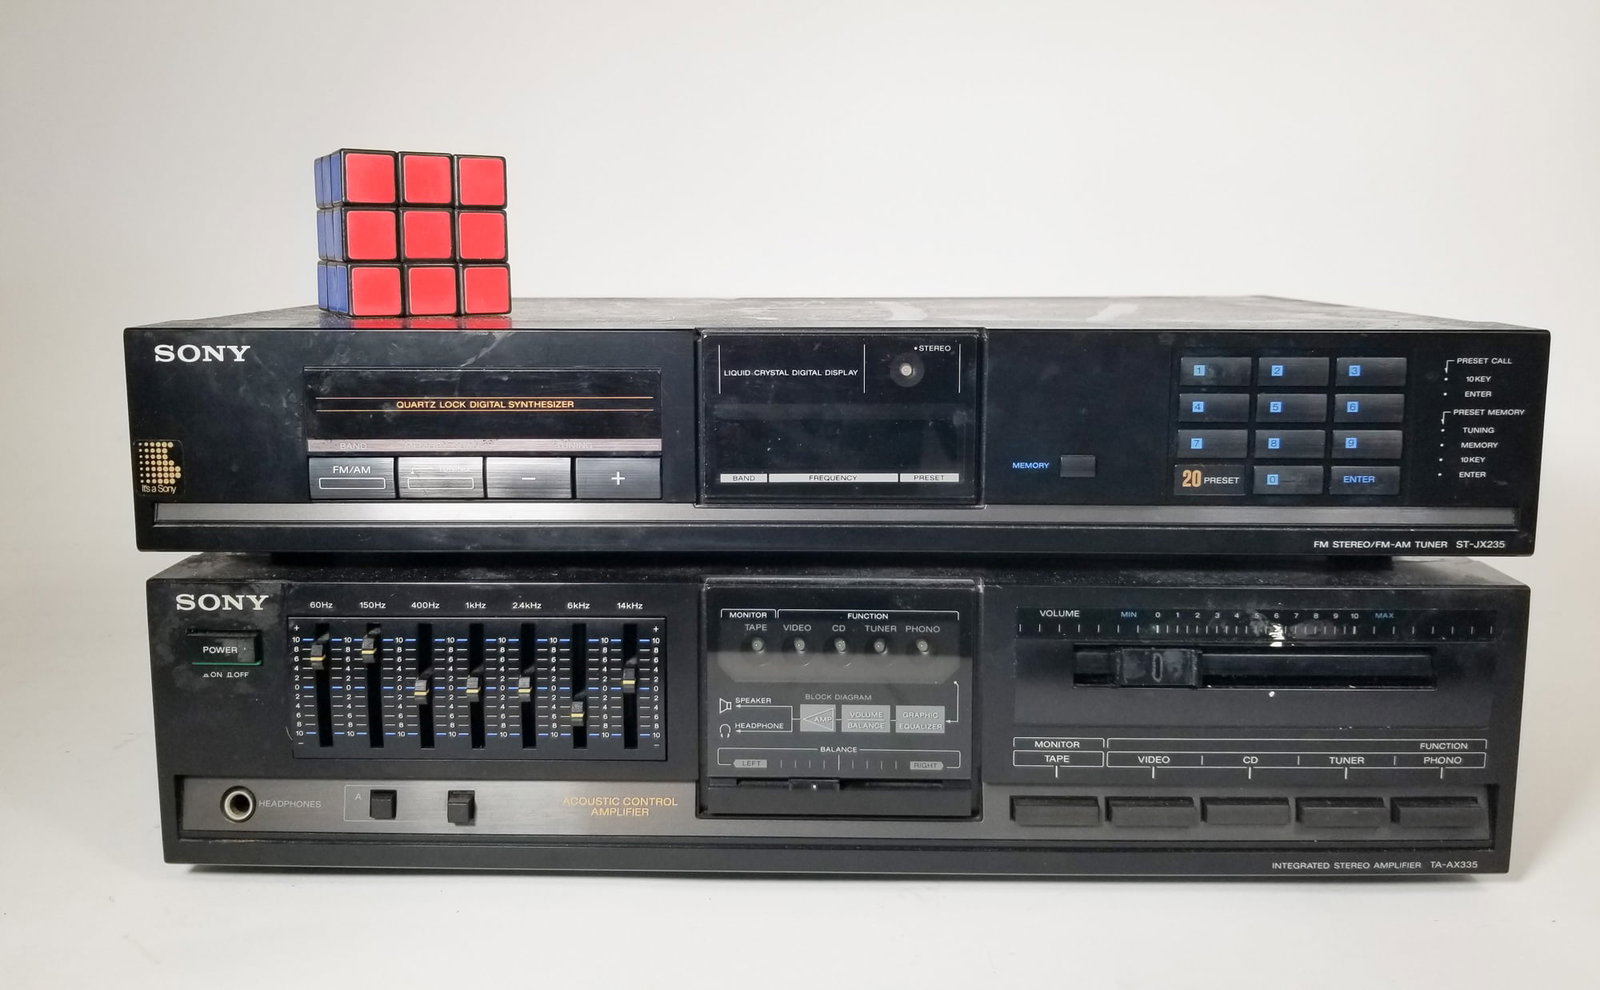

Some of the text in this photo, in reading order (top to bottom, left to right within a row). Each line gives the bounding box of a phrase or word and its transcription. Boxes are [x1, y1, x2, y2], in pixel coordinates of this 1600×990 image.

[154, 344, 250, 362] SONY
[724, 369, 858, 377] LIQUID CRYSTAL DIGITAL DISPLAY
[396, 401, 436, 409] QUARTZ
[439, 401, 466, 409] LOCK
[470, 401, 505, 409] DIGITAL
[332, 466, 371, 474] FM/AM
[1182, 469, 1201, 488] 20
[158, 485, 177, 494] Sony
[1456, 541, 1505, 549] ST-JX235
[176, 594, 269, 611] SONY
[783, 624, 812, 632] VIDEO
[832, 624, 846, 632] CD
[864, 625, 897, 633] TUNER
[905, 625, 940, 633] PHONO
[1044, 755, 1070, 763] TAPE
[1138, 756, 1170, 764] VIDEO
[1243, 756, 1258, 764] CD
[1423, 756, 1462, 764] PHONO
[258, 800, 322, 808] HEADPHONES
[562, 797, 678, 806] ACOUSTIC CONTROL
[591, 808, 649, 816] AMPLIFIER
[1430, 861, 1478, 869] TA-AX335
